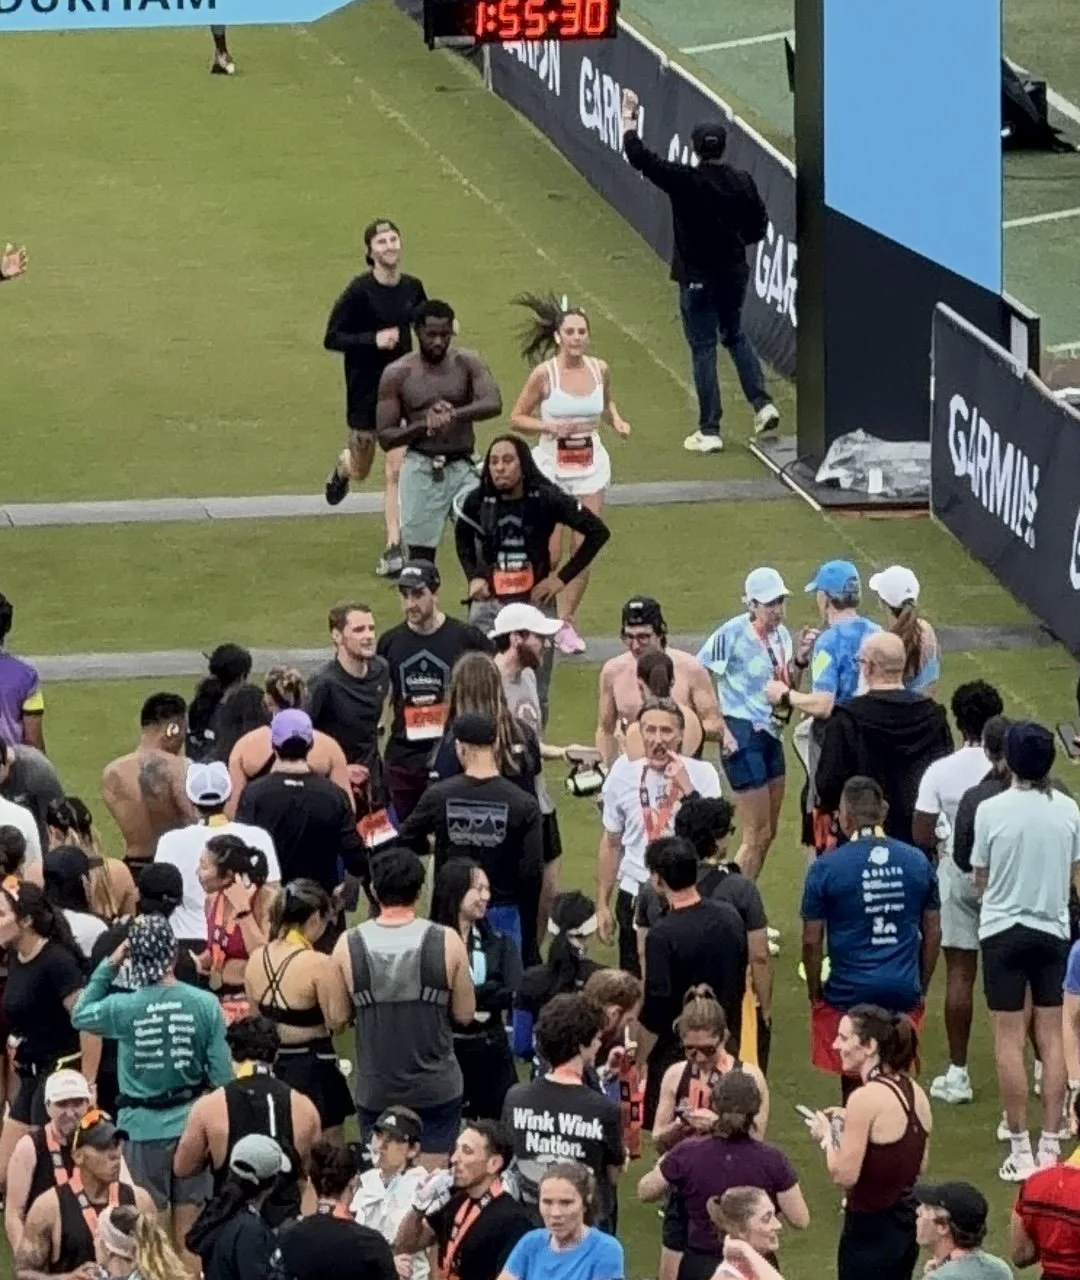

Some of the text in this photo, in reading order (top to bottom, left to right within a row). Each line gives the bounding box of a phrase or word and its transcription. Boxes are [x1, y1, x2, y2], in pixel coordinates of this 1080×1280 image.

[948, 393, 1040, 540] GARMIN
[513, 1107, 604, 1141] Wink Wink
[525, 1130, 587, 1158] Nation.
